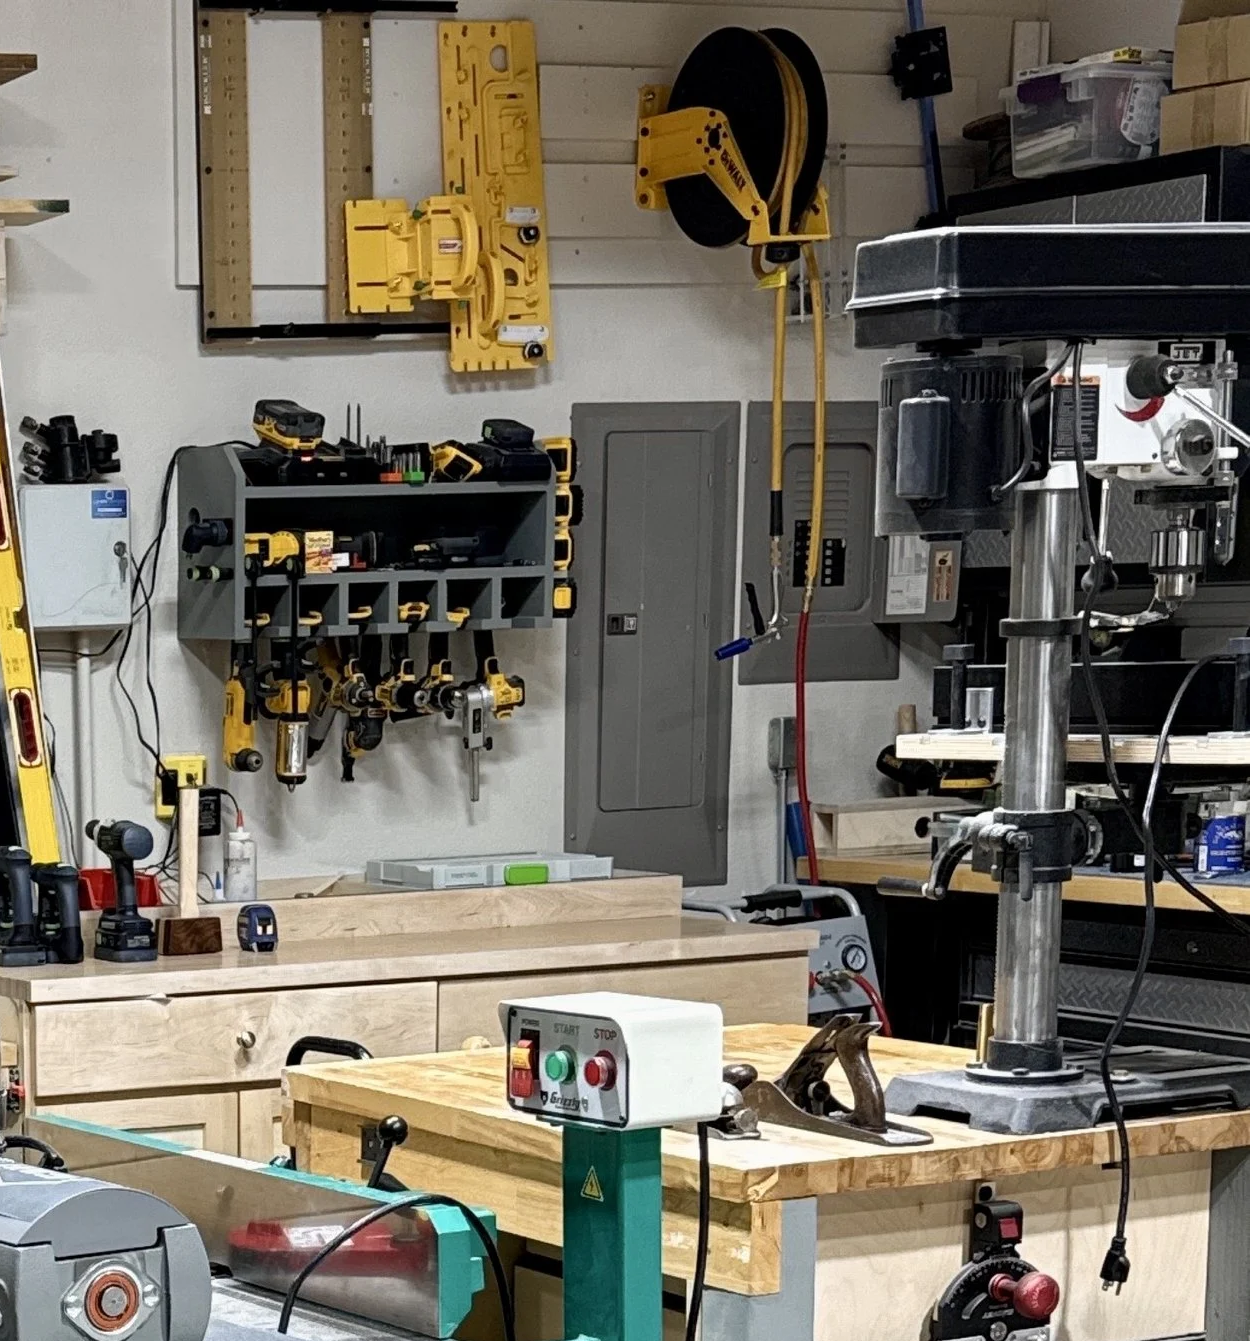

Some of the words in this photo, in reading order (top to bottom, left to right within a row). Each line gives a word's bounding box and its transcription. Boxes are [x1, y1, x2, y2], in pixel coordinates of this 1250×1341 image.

[1172, 345, 1201, 360] JET
[553, 1023, 580, 1035] START
[594, 1028, 617, 1040] STOP
[550, 1092, 580, 1112] Grizzly
